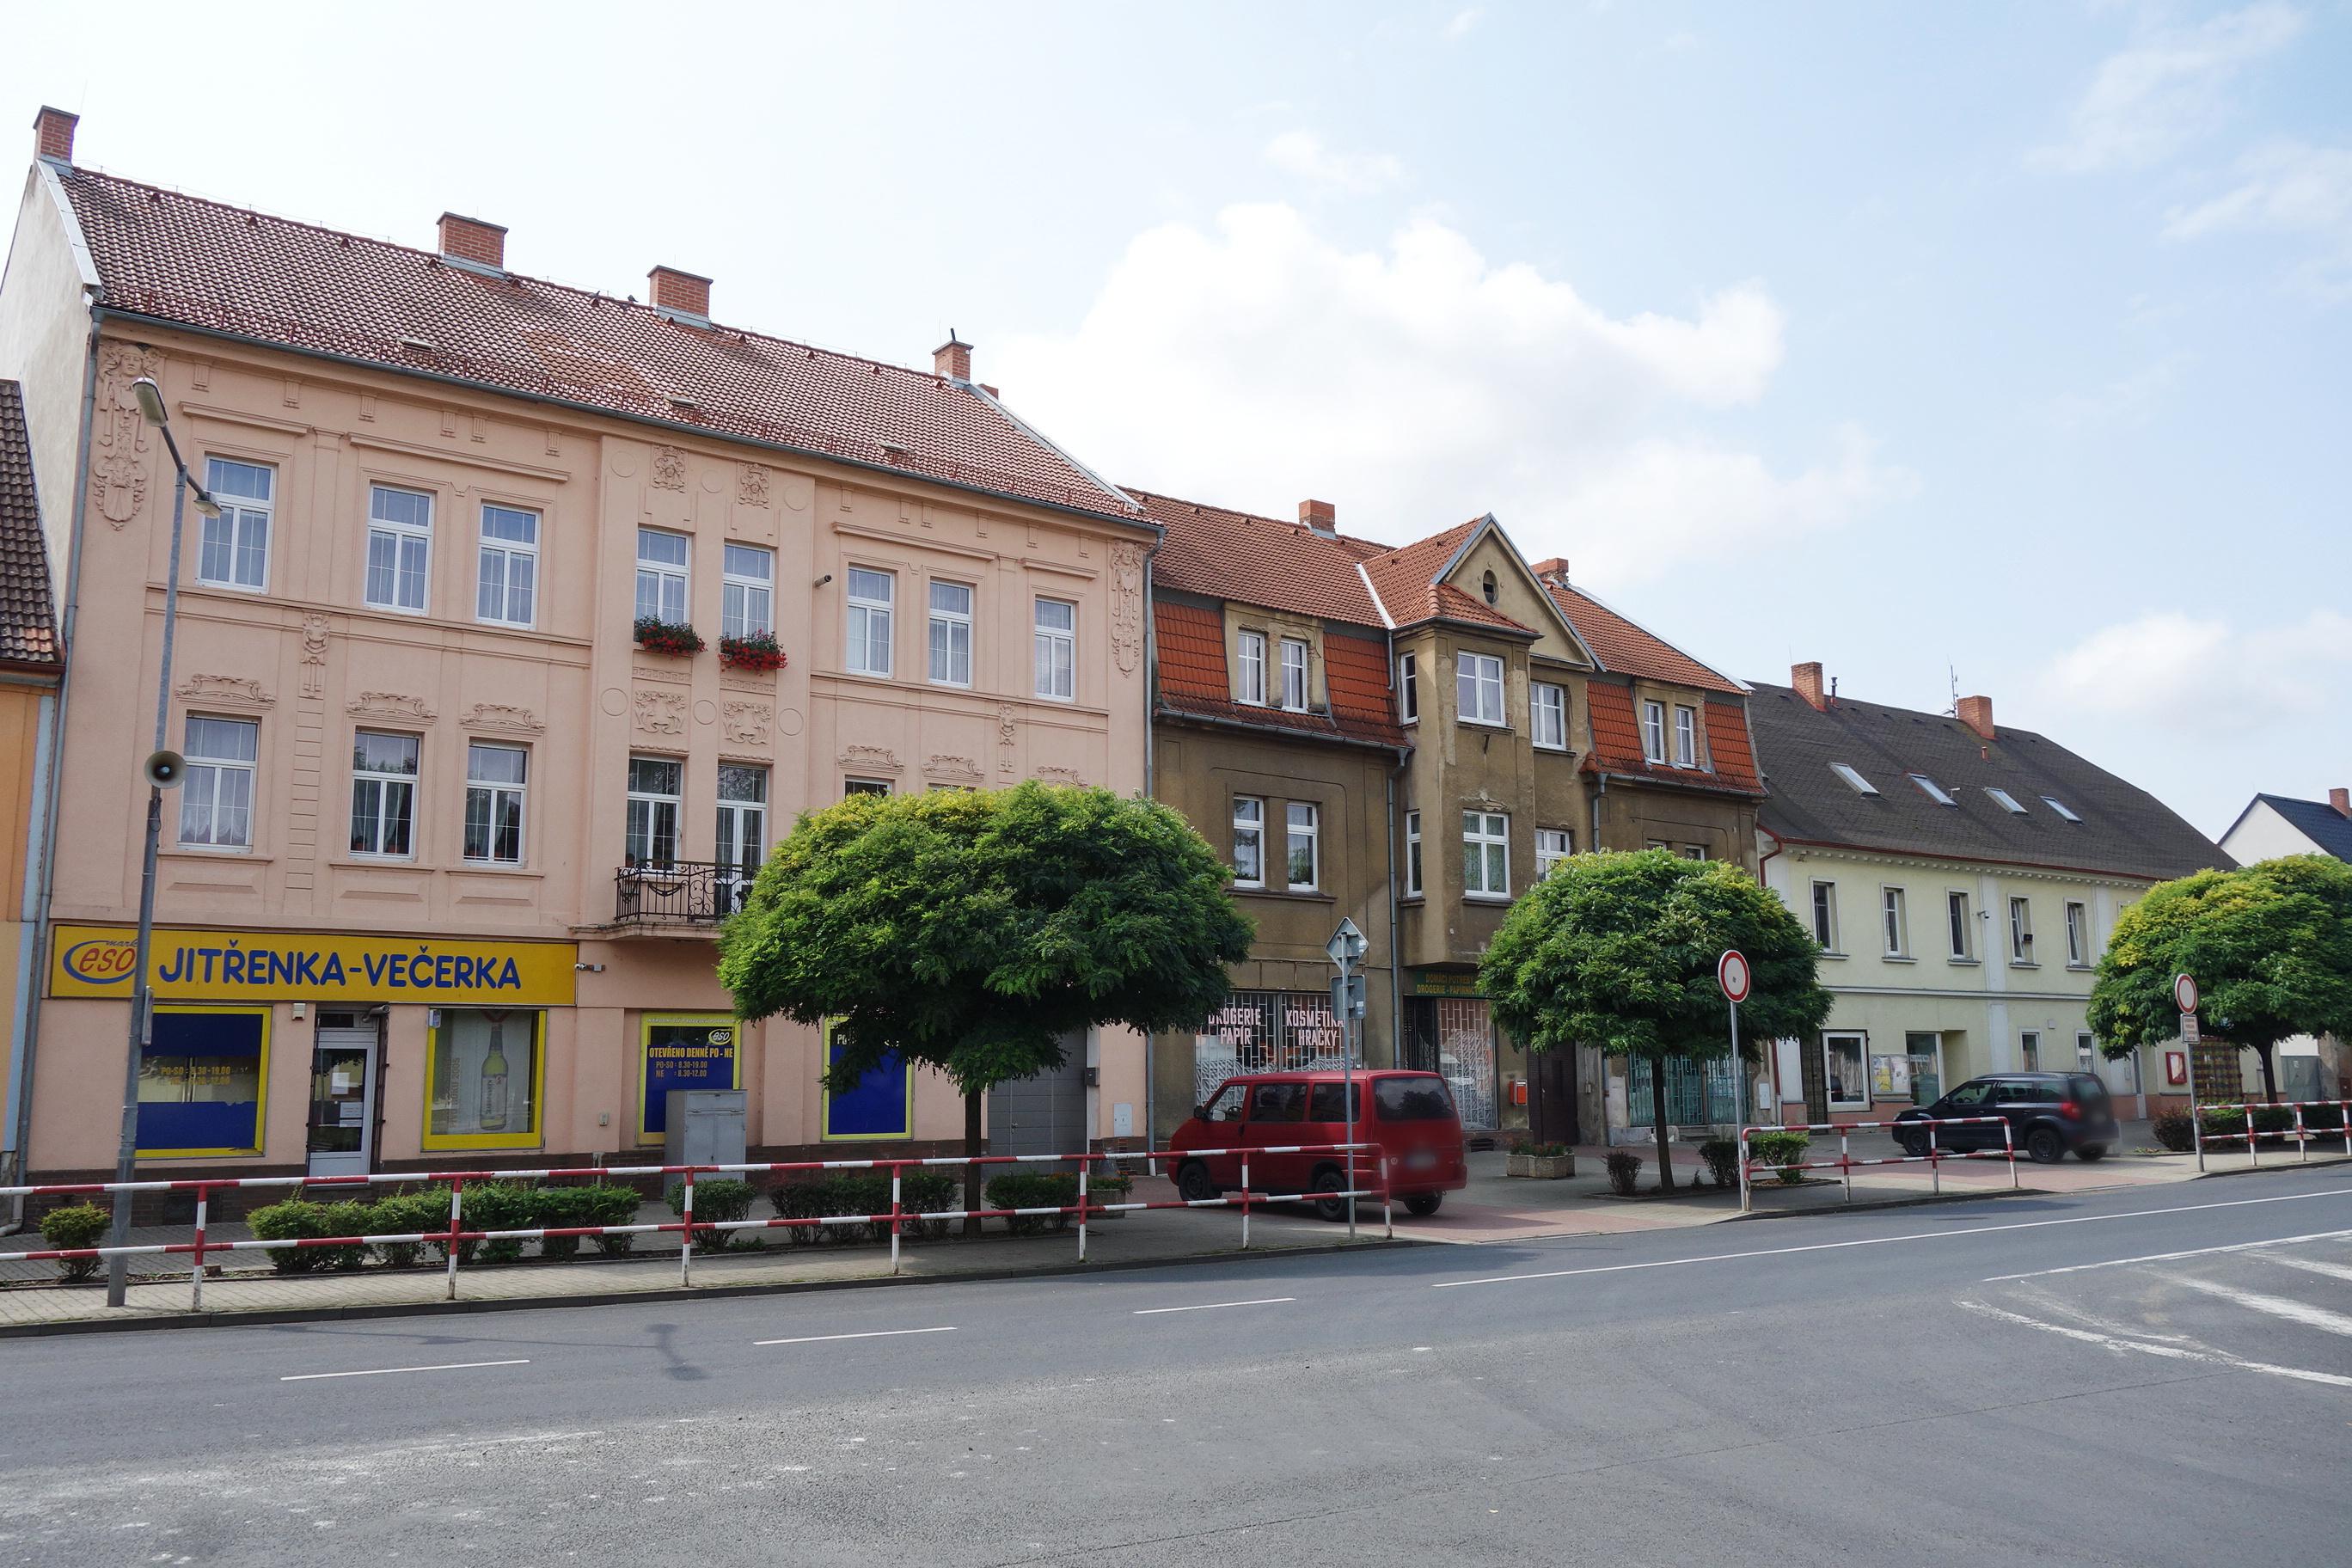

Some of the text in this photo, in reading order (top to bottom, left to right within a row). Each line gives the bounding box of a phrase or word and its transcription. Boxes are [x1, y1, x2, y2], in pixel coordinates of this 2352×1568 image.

[78, 947, 135, 973] eso
[159, 939, 521, 989] JITŘENKA-VEČERKA
[1417, 984, 1446, 994] DROGERIE
[713, 1032, 730, 1041] eso
[1220, 1026, 1252, 1045] PAPÍR
[1298, 1027, 1338, 1046] HRAČKY
[649, 1046, 685, 1058] OTEVŘENO
[686, 1045, 709, 1058] DENNĚ
[709, 1048, 720, 1058] PO
[724, 1048, 733, 1058] NE
[655, 1069, 665, 1078] NE
